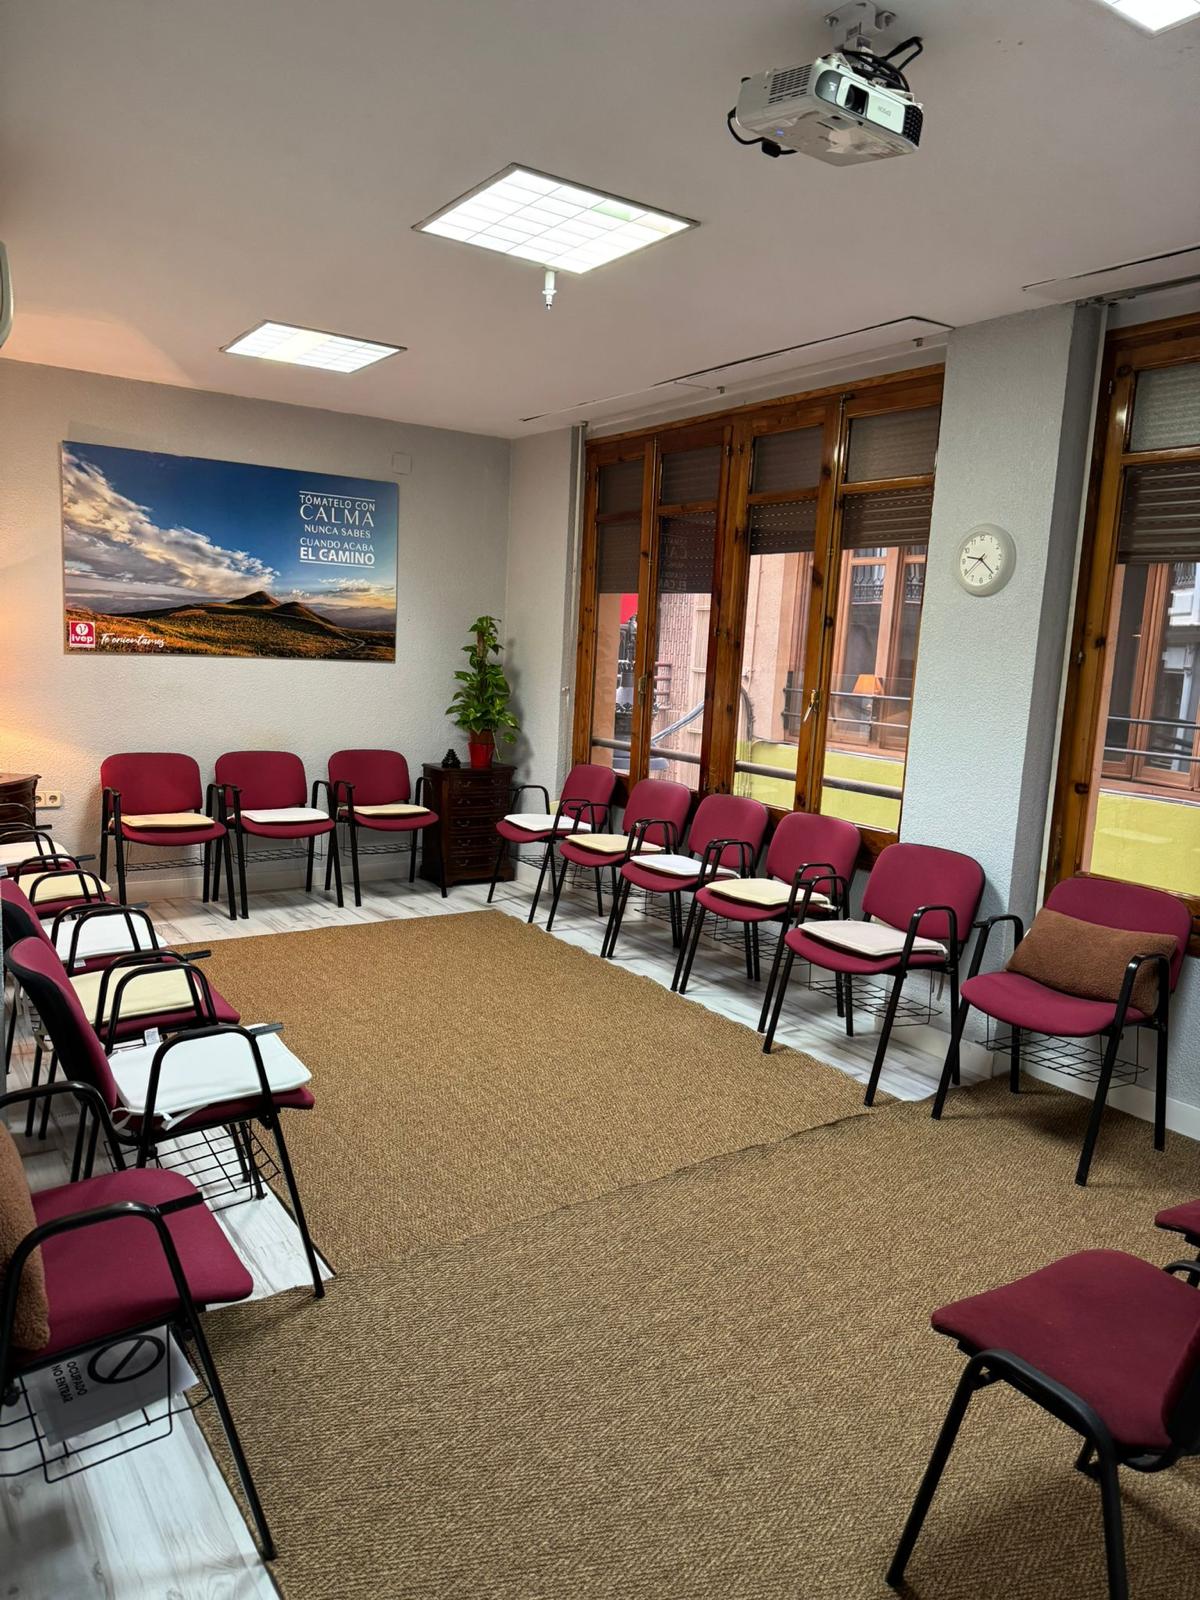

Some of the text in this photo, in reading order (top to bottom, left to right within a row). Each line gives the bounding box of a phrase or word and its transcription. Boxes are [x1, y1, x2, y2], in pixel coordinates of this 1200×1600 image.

[355, 501, 376, 512] CON
[299, 503, 375, 528] CALMA
[304, 524, 371, 539] NUNCA SABES
[300, 537, 375, 552] CUANDO ACABA
[300, 547, 375, 565] EL CAMINO
[71, 634, 93, 644] ivep
[101, 632, 166, 649] Te orientamos
[51, 1363, 74, 1404] NO ENTRAR
[66, 1361, 88, 1396] OCUPADO
